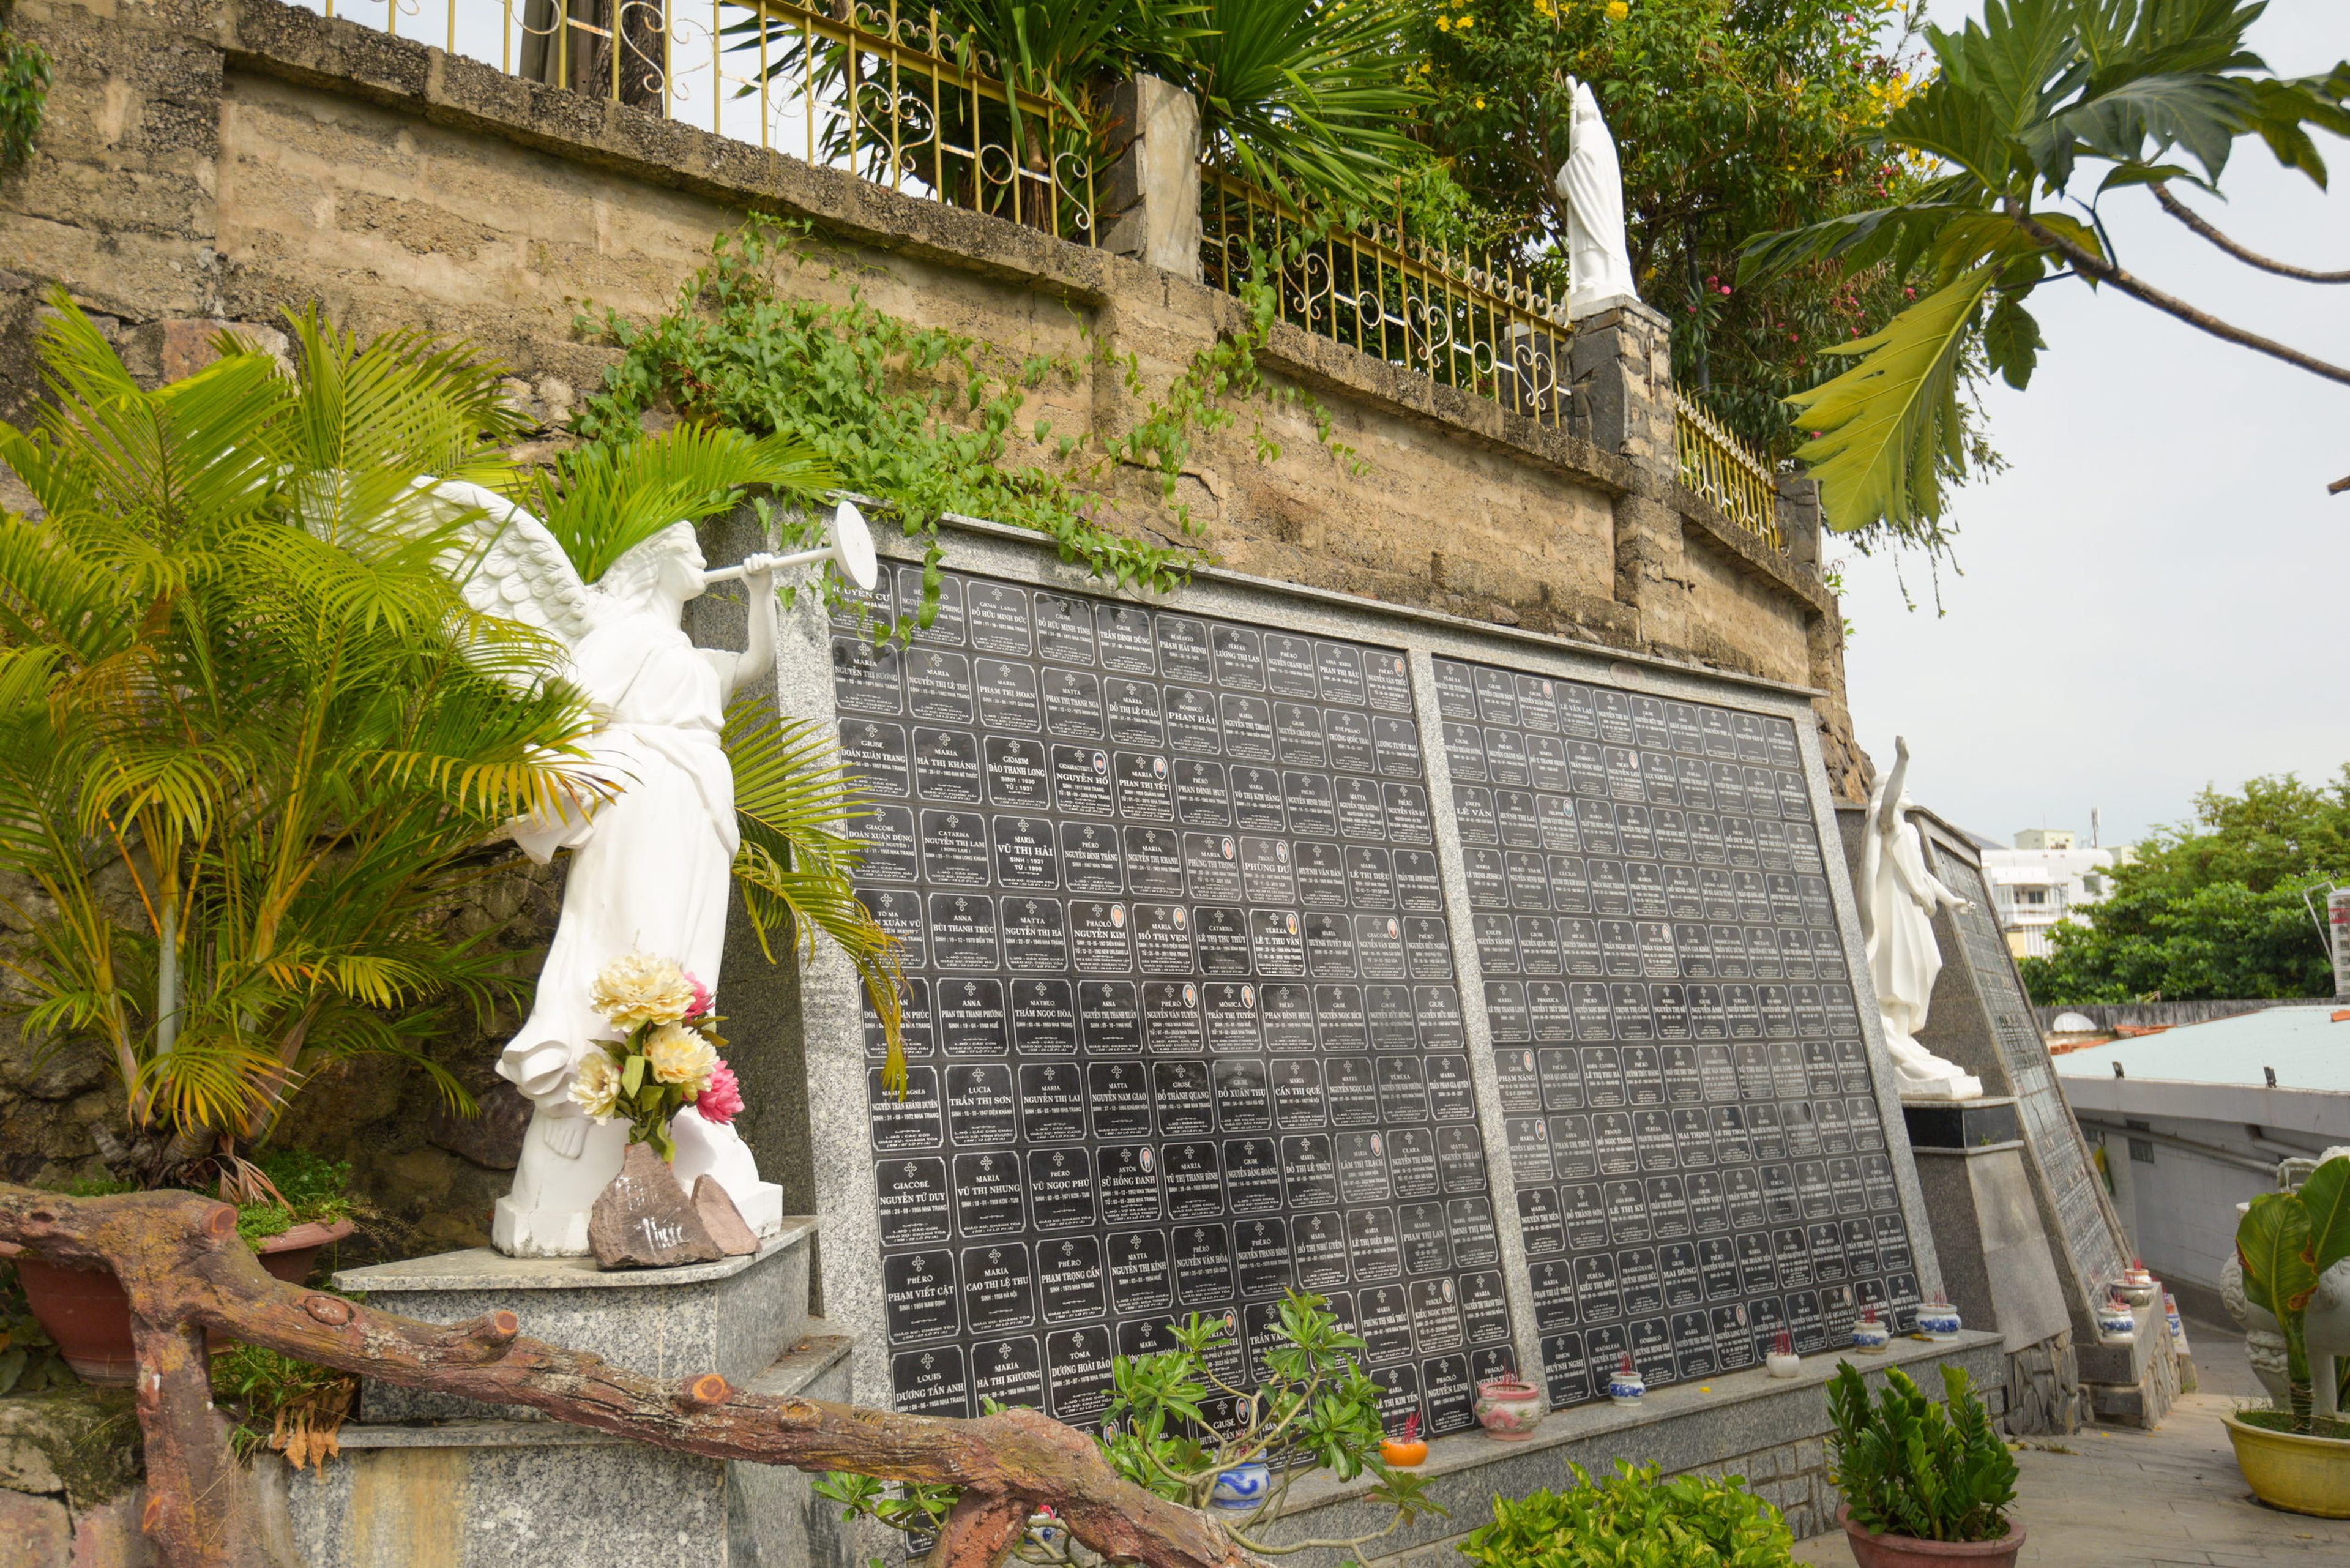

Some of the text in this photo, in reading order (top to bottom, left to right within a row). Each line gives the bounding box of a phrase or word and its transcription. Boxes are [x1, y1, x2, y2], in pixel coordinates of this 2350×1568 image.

[853, 658, 878, 666] MARIA
[863, 668, 875, 679] THỊ
[927, 668, 949, 677] MARIA
[934, 680, 946, 689] THỊ
[1001, 688, 1014, 697] THỊ
[1119, 705, 1130, 714] THỊ
[930, 758, 946, 768] THỊ
[1140, 781, 1153, 790] THỊ
[1014, 835, 1035, 844] MARIA
[1013, 845, 1032, 856] THỊ
[1020, 917, 1045, 926] MATTA
[1037, 928, 1050, 937] THỊ
[1152, 933, 1168, 942] THỊ
[1291, 1087, 1304, 1096] THỊ
[975, 1097, 992, 1105] THỊ
[971, 1186, 987, 1195] THỊ
[984, 1267, 1009, 1276] MARIA
[983, 1280, 998, 1289] THỊ
[994, 1362, 1019, 1372] MARIA
[917, 1372, 941, 1383] LOUIS
[990, 1376, 1005, 1386] THỊ
